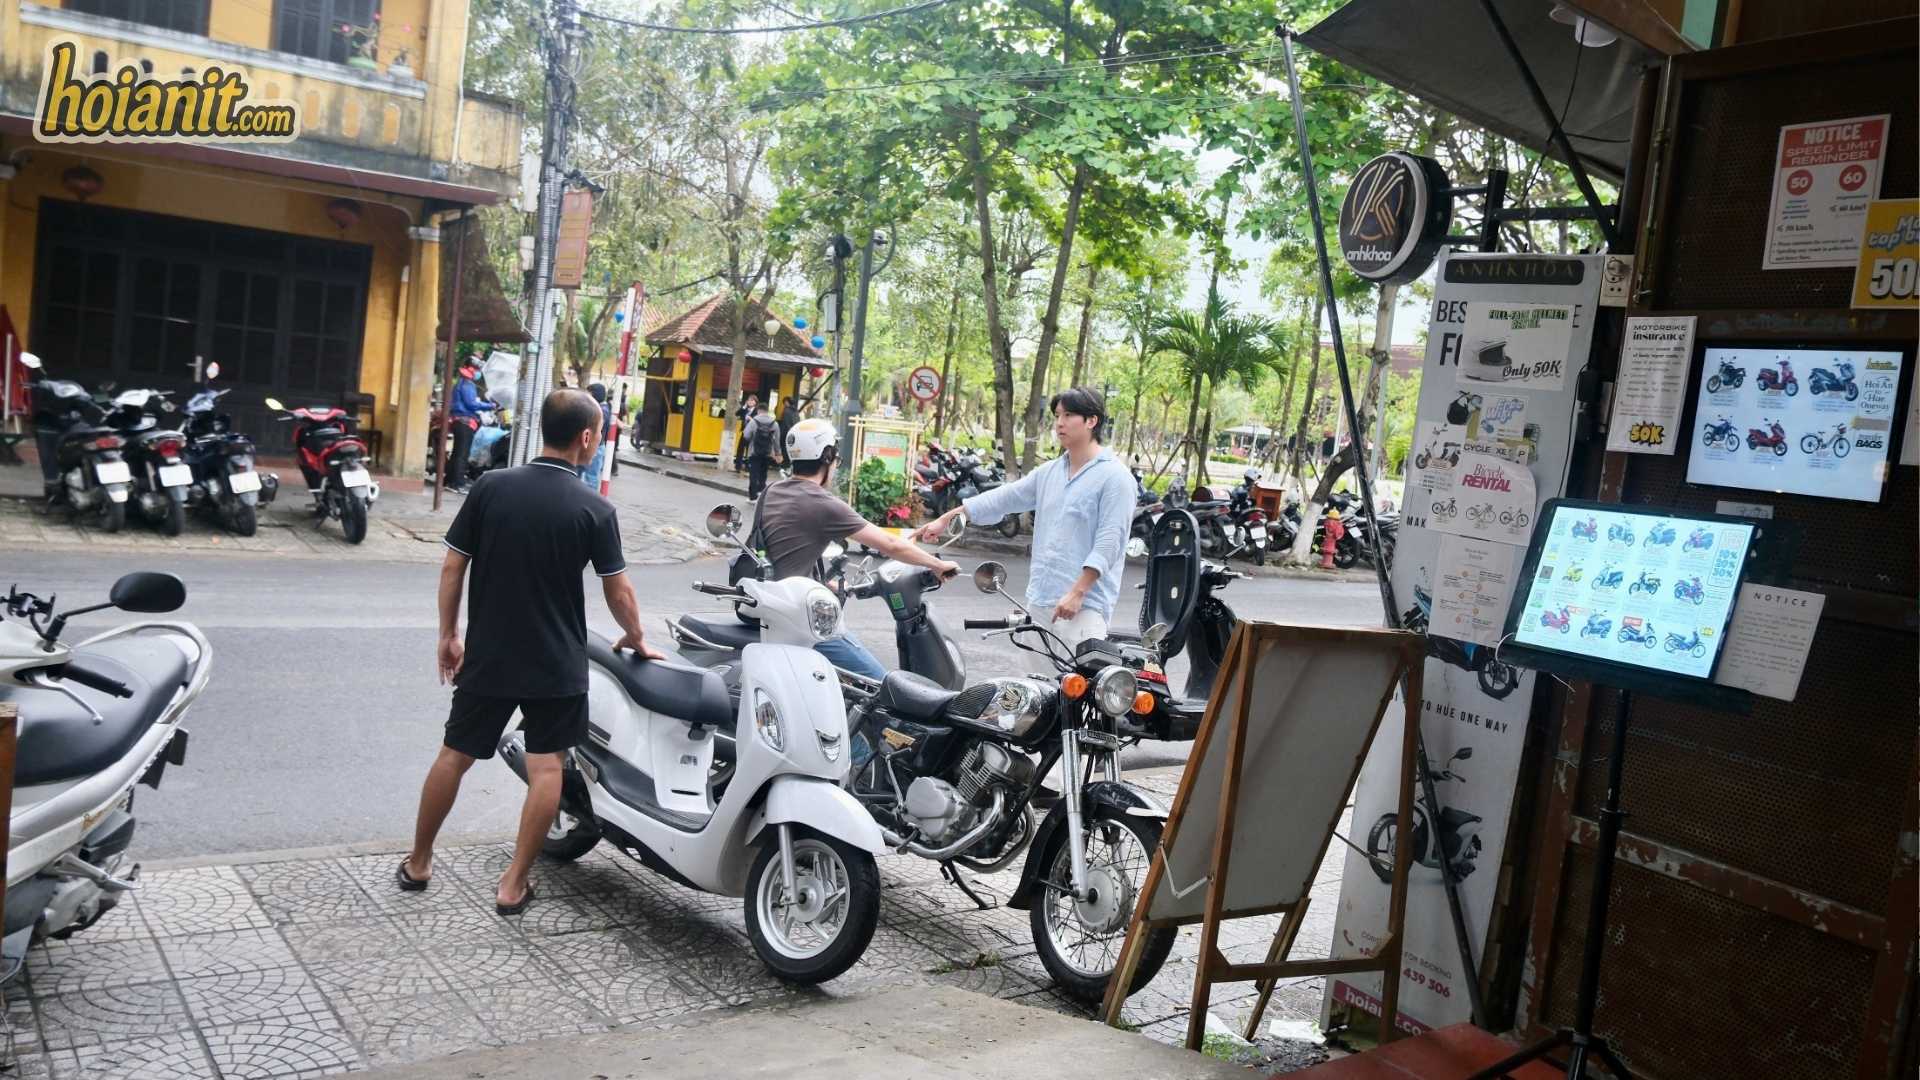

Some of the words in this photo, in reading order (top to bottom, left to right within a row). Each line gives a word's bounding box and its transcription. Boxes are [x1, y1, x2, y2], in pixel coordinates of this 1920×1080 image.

[1804, 123, 1863, 144] NOTICE
[1786, 145, 1835, 158] SPEED
[1838, 139, 1879, 151] LIMIT
[1791, 151, 1870, 166] REMINDER
[1790, 177, 1809, 188] 50
[1842, 171, 1862, 184] 60
[1868, 232, 1900, 250] top
[1347, 245, 1392, 261] anhkhoa
[1455, 262, 1576, 279] ANHKHOA
[1869, 257, 1919, 298] 50
[1633, 332, 1685, 340] insurance
[1502, 364, 1531, 379] Only
[1533, 360, 1562, 374] 50K
[1630, 423, 1664, 444] 50K
[1463, 443, 1491, 454] CYCLE
[1855, 440, 1882, 449] BAGS
[1462, 475, 1511, 492] RENTAL
[1753, 592, 1808, 607] NOTICE
[1436, 703, 1456, 718] HUE
[1460, 711, 1480, 726] ONE
[1484, 718, 1509, 734] WAY
[1403, 967, 1426, 984] 439
[1427, 978, 1451, 998] 306
